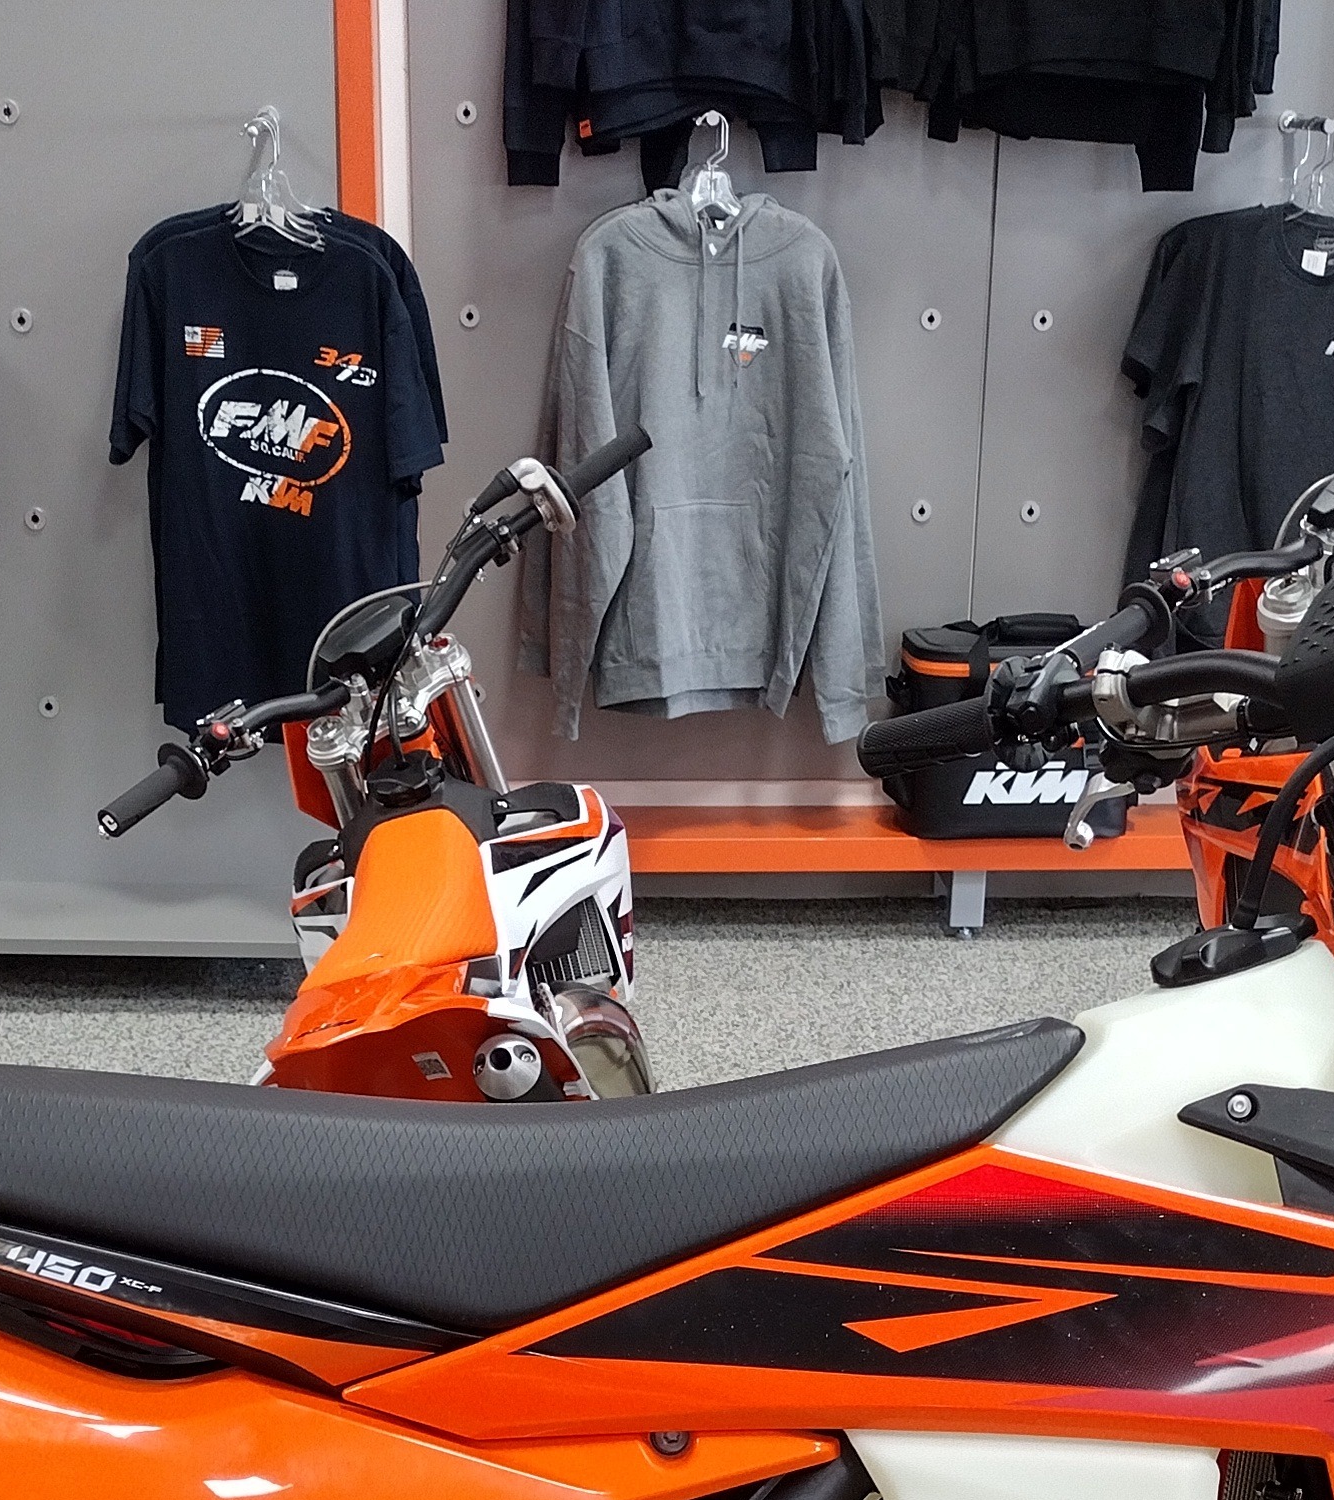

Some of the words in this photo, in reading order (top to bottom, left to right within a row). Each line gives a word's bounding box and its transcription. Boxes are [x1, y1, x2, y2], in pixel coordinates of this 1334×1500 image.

[209, 399, 340, 454] FMF
[239, 475, 314, 517] KTM
[962, 760, 1090, 805] KTM
[6, 1245, 118, 1293] 450
[119, 1276, 163, 1294] XC-F
